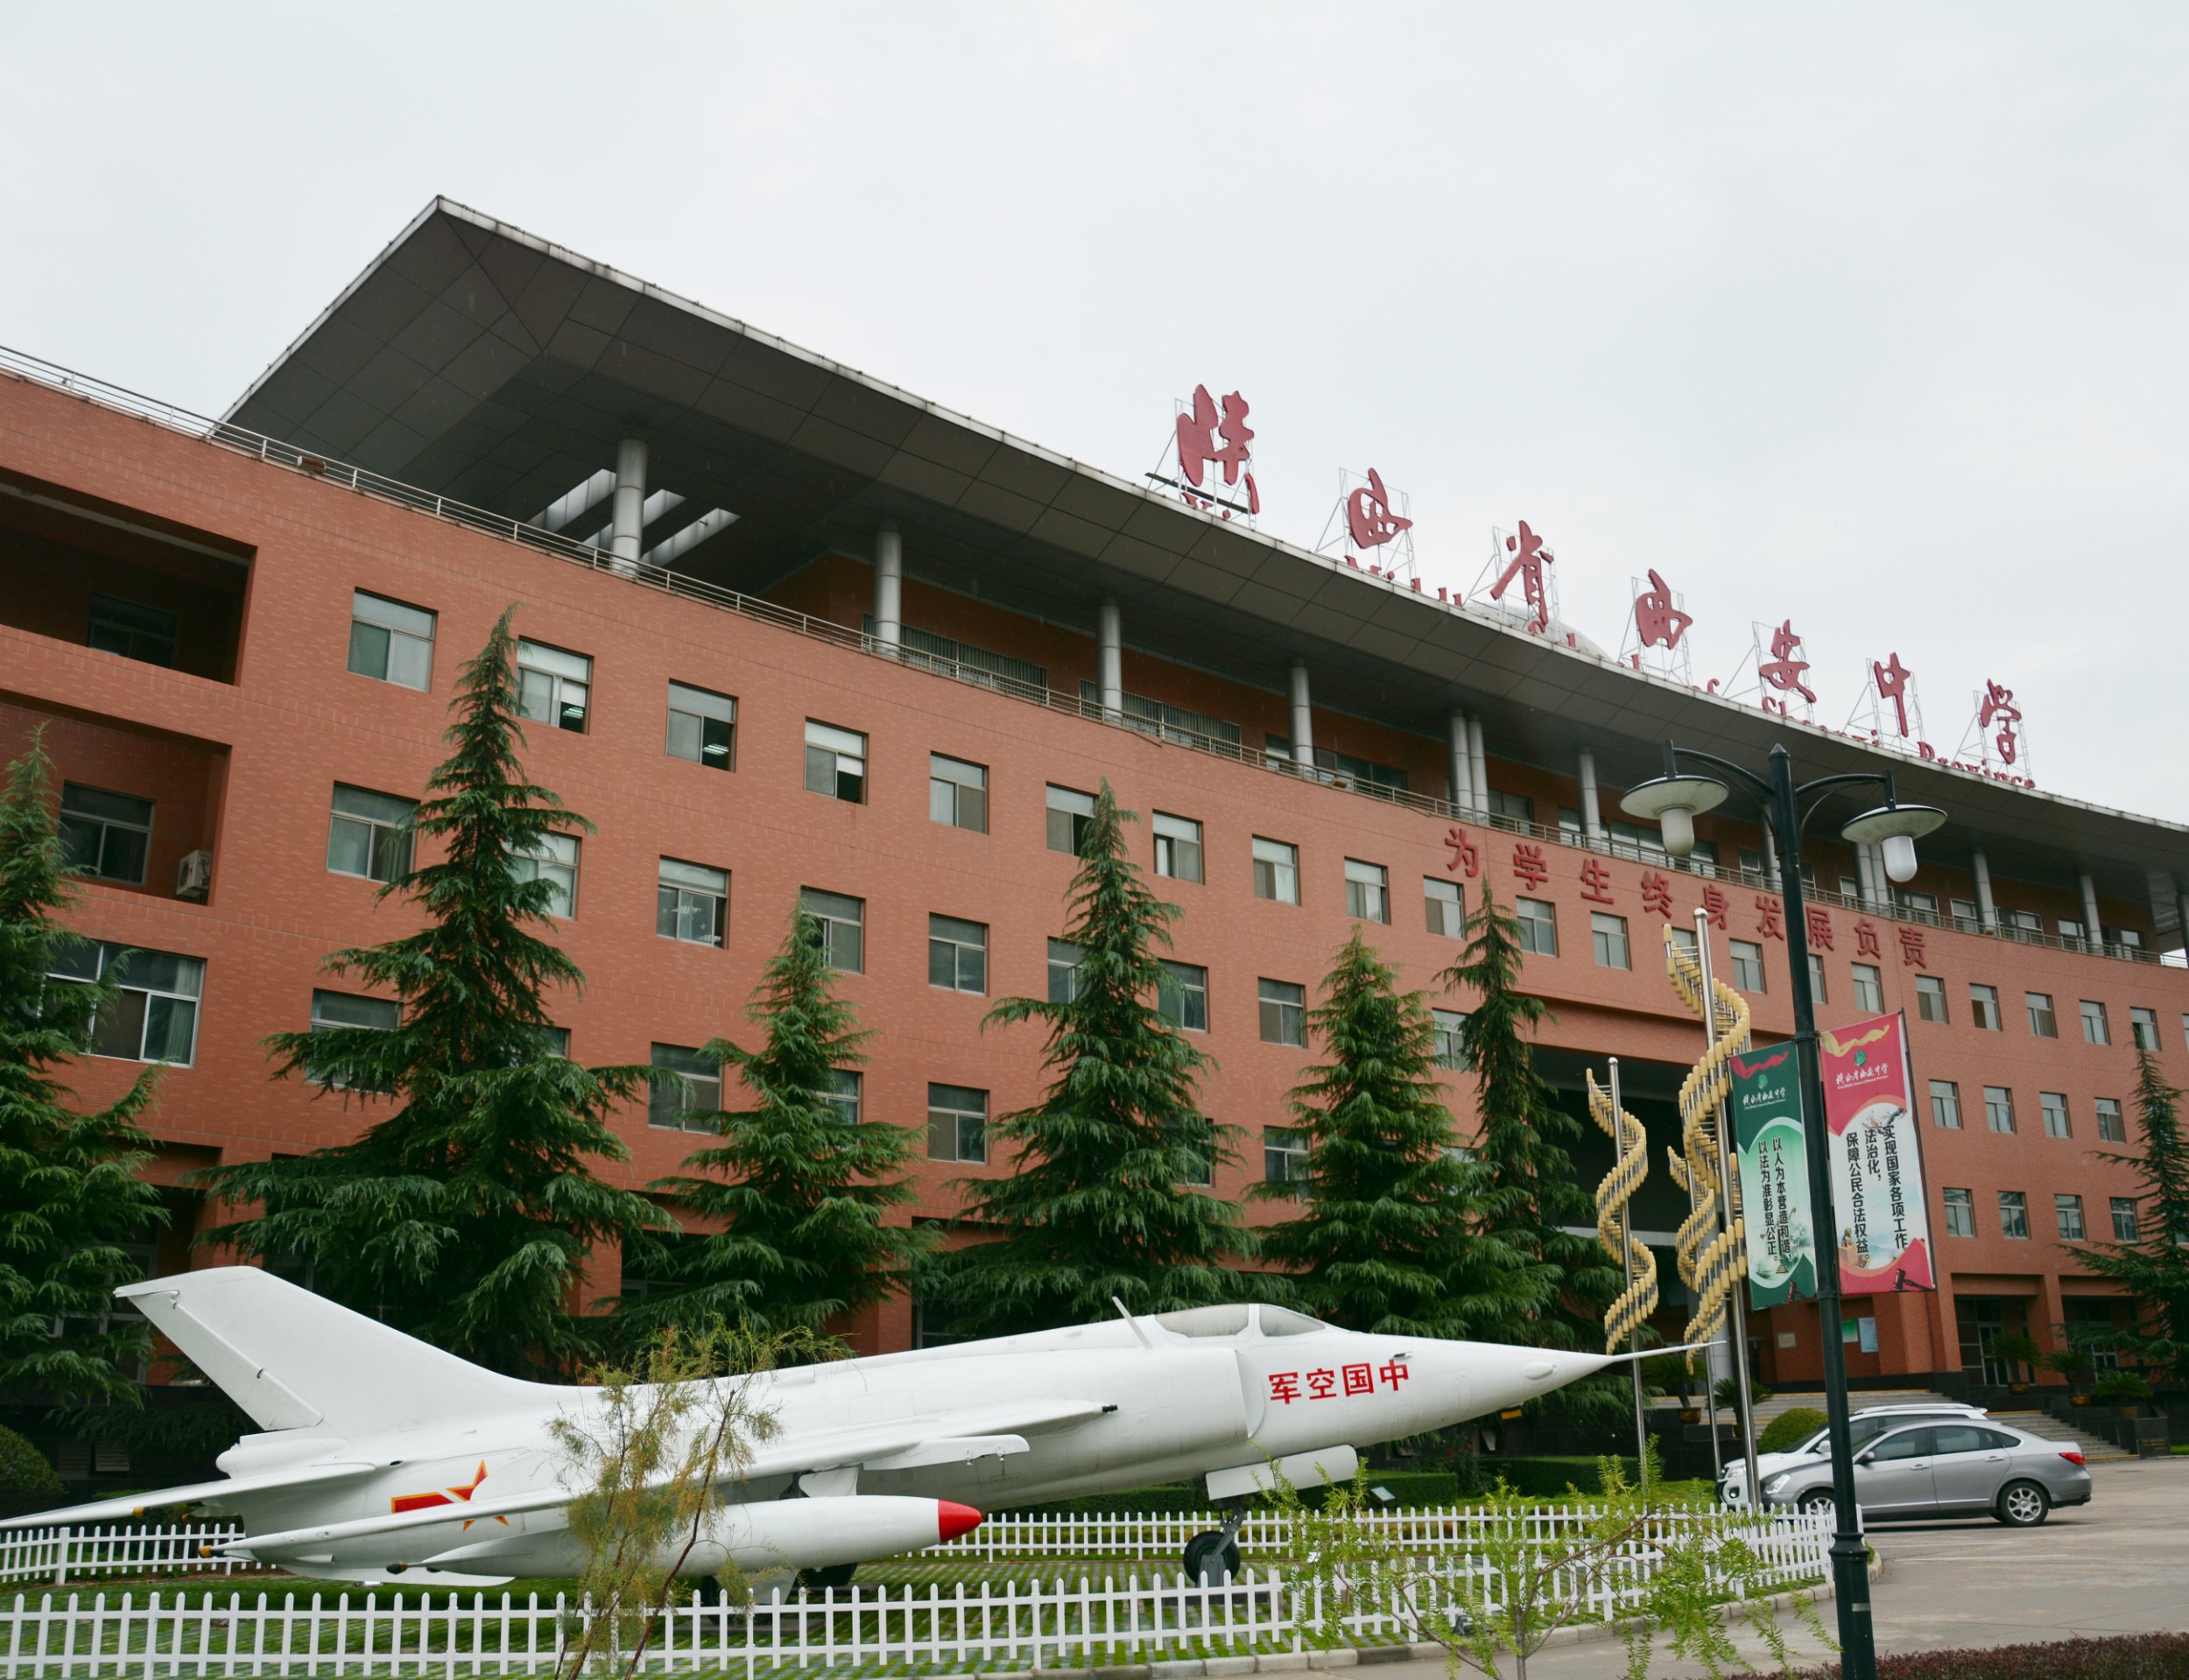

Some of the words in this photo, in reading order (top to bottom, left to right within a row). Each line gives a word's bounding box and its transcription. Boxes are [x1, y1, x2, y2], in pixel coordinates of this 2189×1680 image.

[1444, 827, 1927, 968] 为学生终身发展负责
[1846, 1132, 1869, 1260] 保障公民合法权益。
